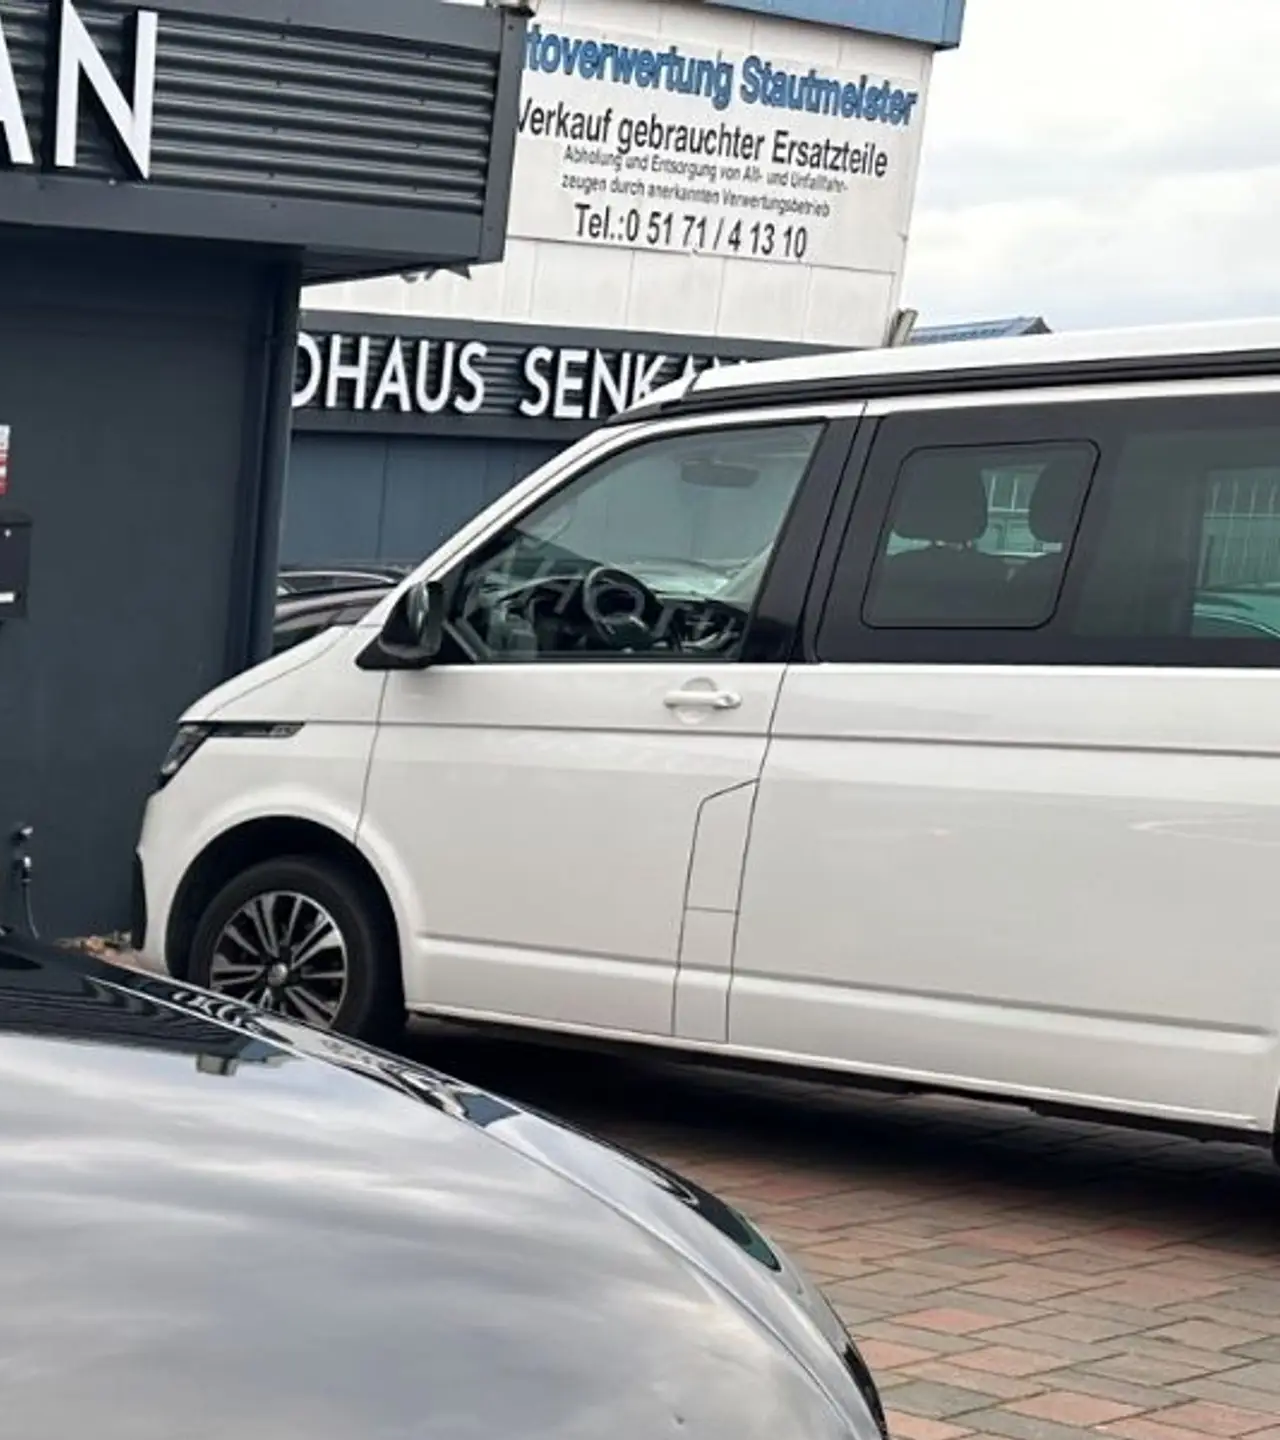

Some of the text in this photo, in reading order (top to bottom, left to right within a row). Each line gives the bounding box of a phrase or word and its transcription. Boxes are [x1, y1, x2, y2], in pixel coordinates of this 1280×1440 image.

[740, 55, 919, 126] Stautmeister
[563, 144, 623, 172] Abholung
[625, 154, 648, 171] und
[650, 154, 718, 183] Entsorgung
[720, 166, 741, 181] von
[766, 171, 789, 186] und
[617, 112, 765, 161] gebrauchter
[772, 129, 889, 178] Ersatzteile
[561, 174, 831, 217] zeugen durch anerkannten Verwertungsbetrieb
[646, 210, 674, 246] 51
[682, 215, 708, 249] 71
[727, 216, 743, 252] 4
[749, 221, 776, 256] 13
[782, 225, 808, 259] 10
